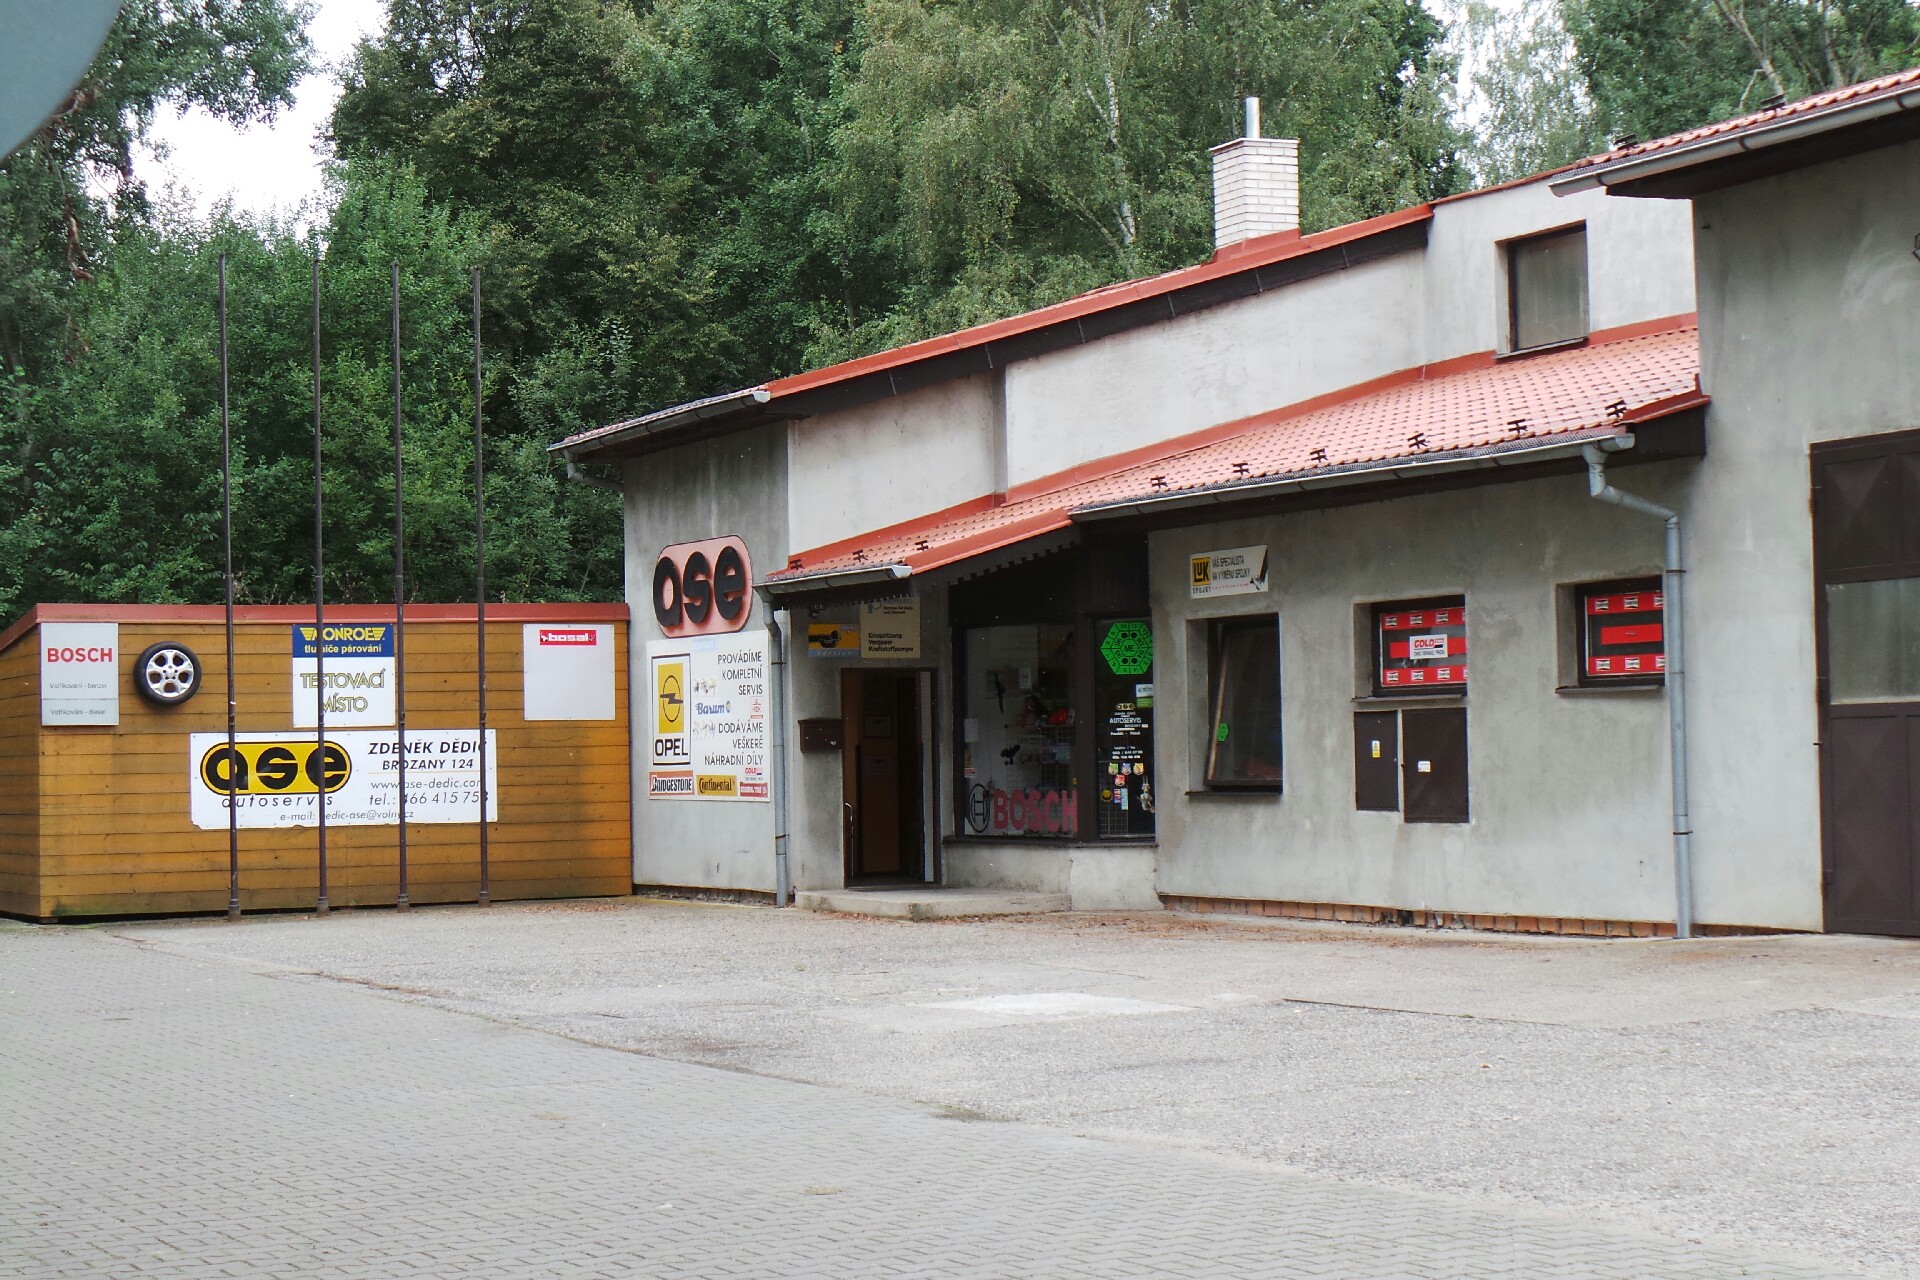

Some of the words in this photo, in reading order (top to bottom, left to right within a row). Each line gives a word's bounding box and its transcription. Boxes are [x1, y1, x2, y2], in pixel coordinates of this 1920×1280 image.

[652, 545, 745, 629] ase
[548, 633, 589, 641] bosal
[1414, 639, 1435, 648] GOLD
[47, 647, 113, 663] BOSCH
[304, 644, 339, 654] tluiče
[341, 643, 382, 655] pérování
[717, 649, 762, 664] PROVÁDÍME
[300, 668, 386, 689] TESTOVACÍ
[722, 664, 762, 680] KOMPLETNÍ
[738, 684, 763, 696] SERVIS
[322, 692, 368, 713] MÍSTO
[696, 702, 725, 715] Barum
[718, 719, 763, 734] DODÁVÁME
[368, 739, 434, 755] ZDENĚK
[655, 738, 689, 756] OPEL
[732, 735, 763, 749] VEŠKERÉ
[452, 758, 474, 769] 124
[704, 751, 744, 766] NÁHRADNÍ
[746, 751, 763, 766] DÍLY
[205, 746, 348, 791] ase
[370, 777, 481, 789] wwwase-dedic.co
[651, 776, 692, 792] BRIDGESTONE
[699, 777, 732, 794] Continental
[221, 794, 334, 808] autoservs
[369, 792, 396, 805] tel.:
[432, 791, 458, 804] 415
[280, 811, 316, 821] e-mail:
[994, 787, 1079, 833] BOSCH
